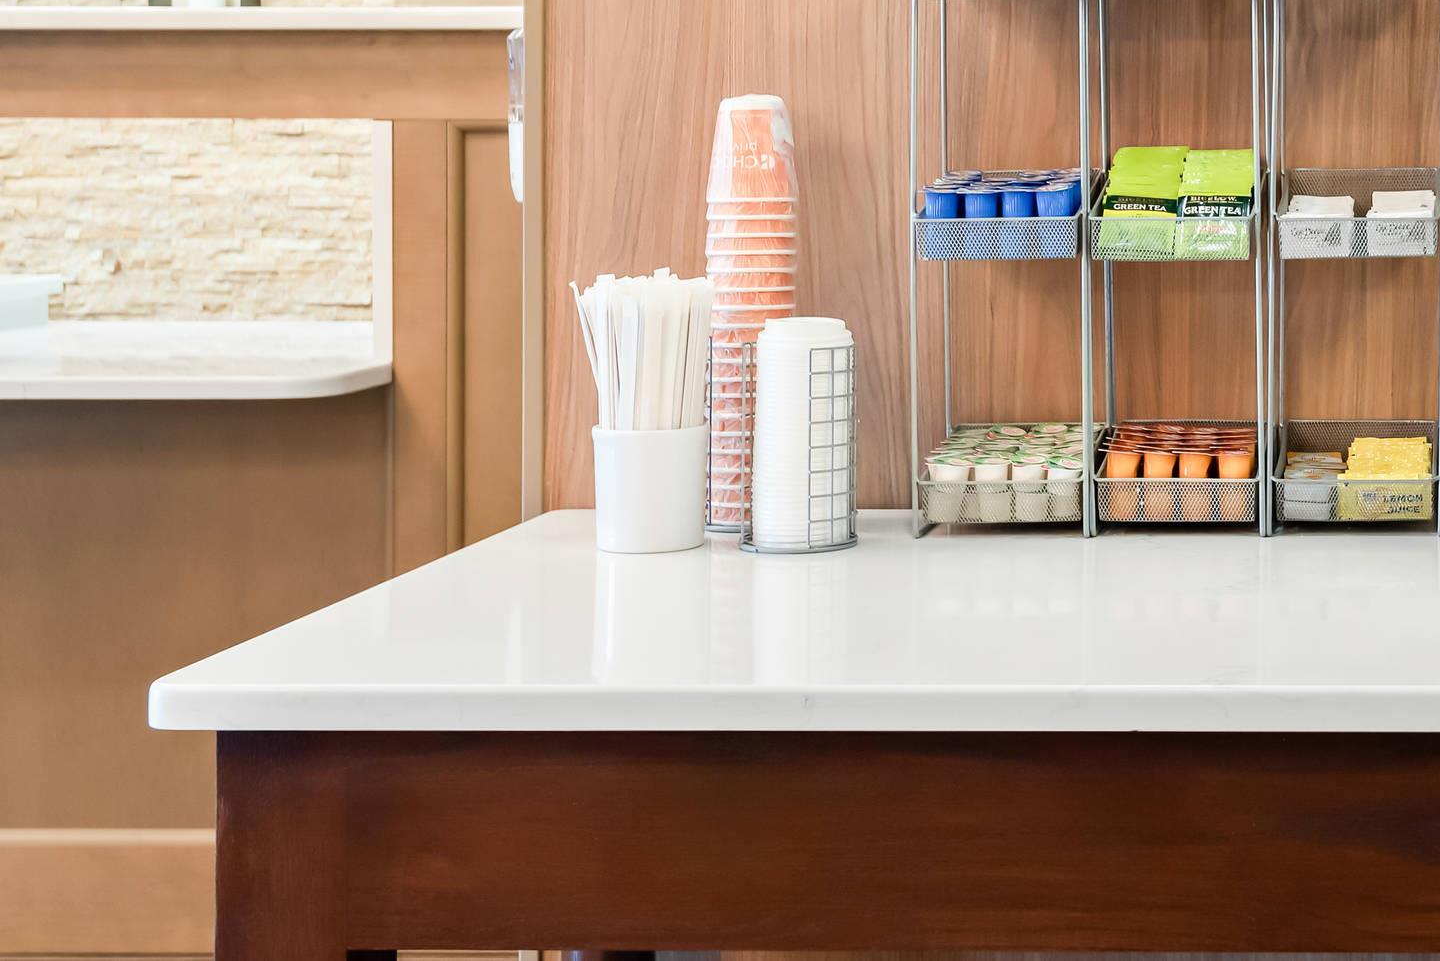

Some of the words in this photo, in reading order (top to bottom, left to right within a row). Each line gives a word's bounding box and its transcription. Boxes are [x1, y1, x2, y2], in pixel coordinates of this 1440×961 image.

[1113, 203, 1147, 211] GREEN
[1148, 204, 1167, 212] TEA
[1183, 205, 1220, 215] GREEN
[1220, 206, 1242, 215] TEA
